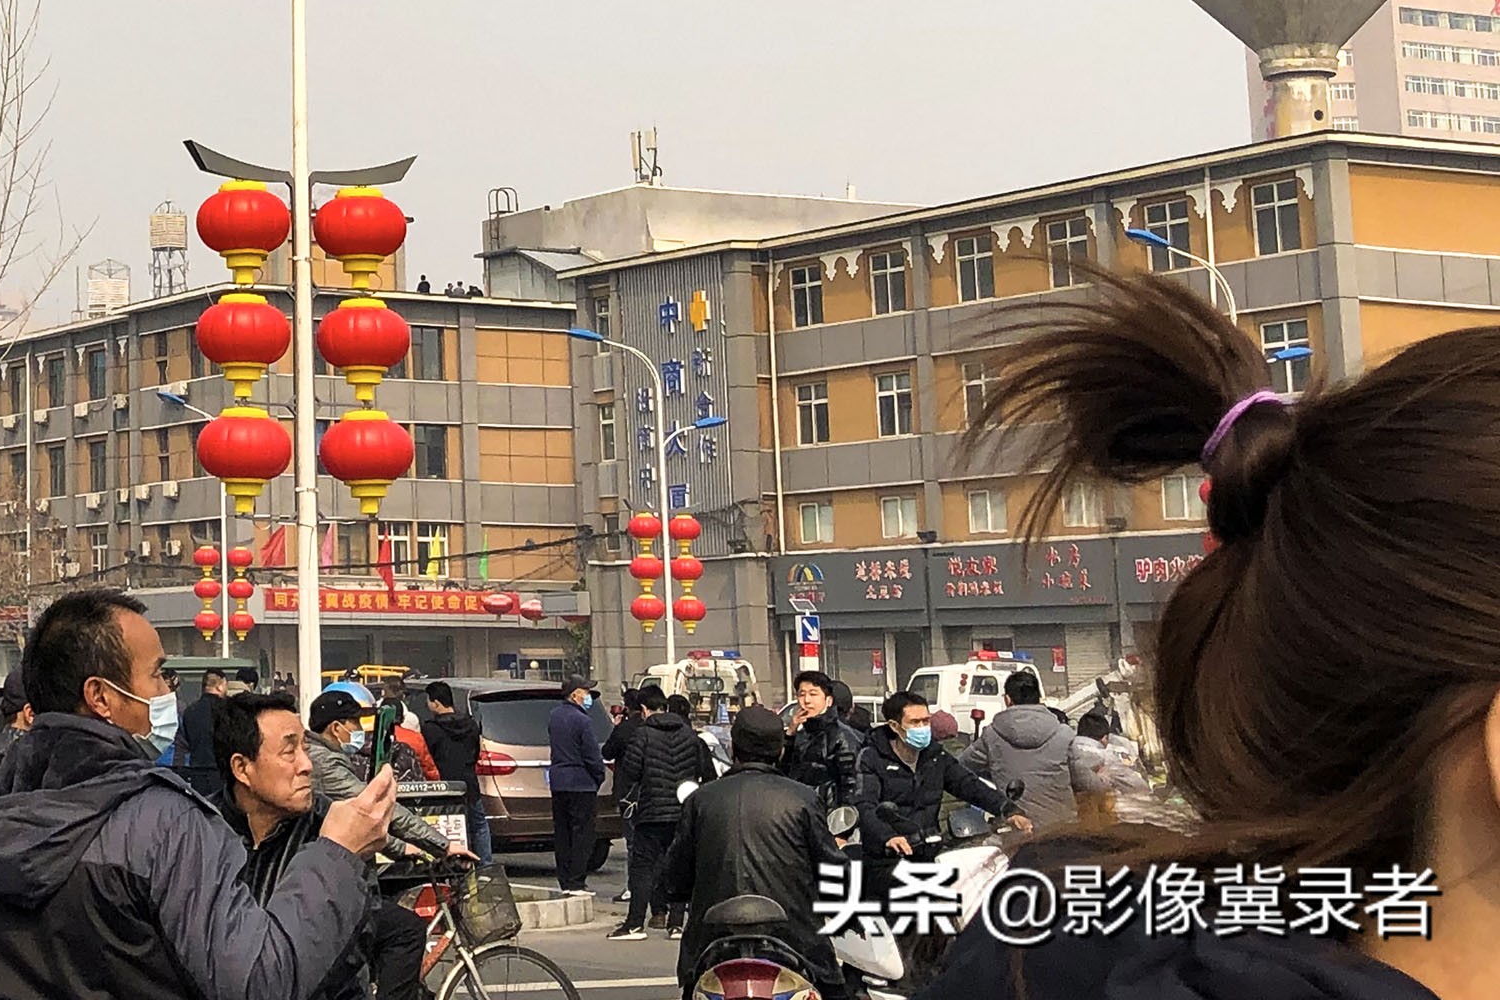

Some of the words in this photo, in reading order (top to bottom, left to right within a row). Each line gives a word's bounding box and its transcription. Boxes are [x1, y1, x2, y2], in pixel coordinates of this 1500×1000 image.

[637, 387, 656, 515] 招商中
[397, 594, 486, 611] 牢记使命促
